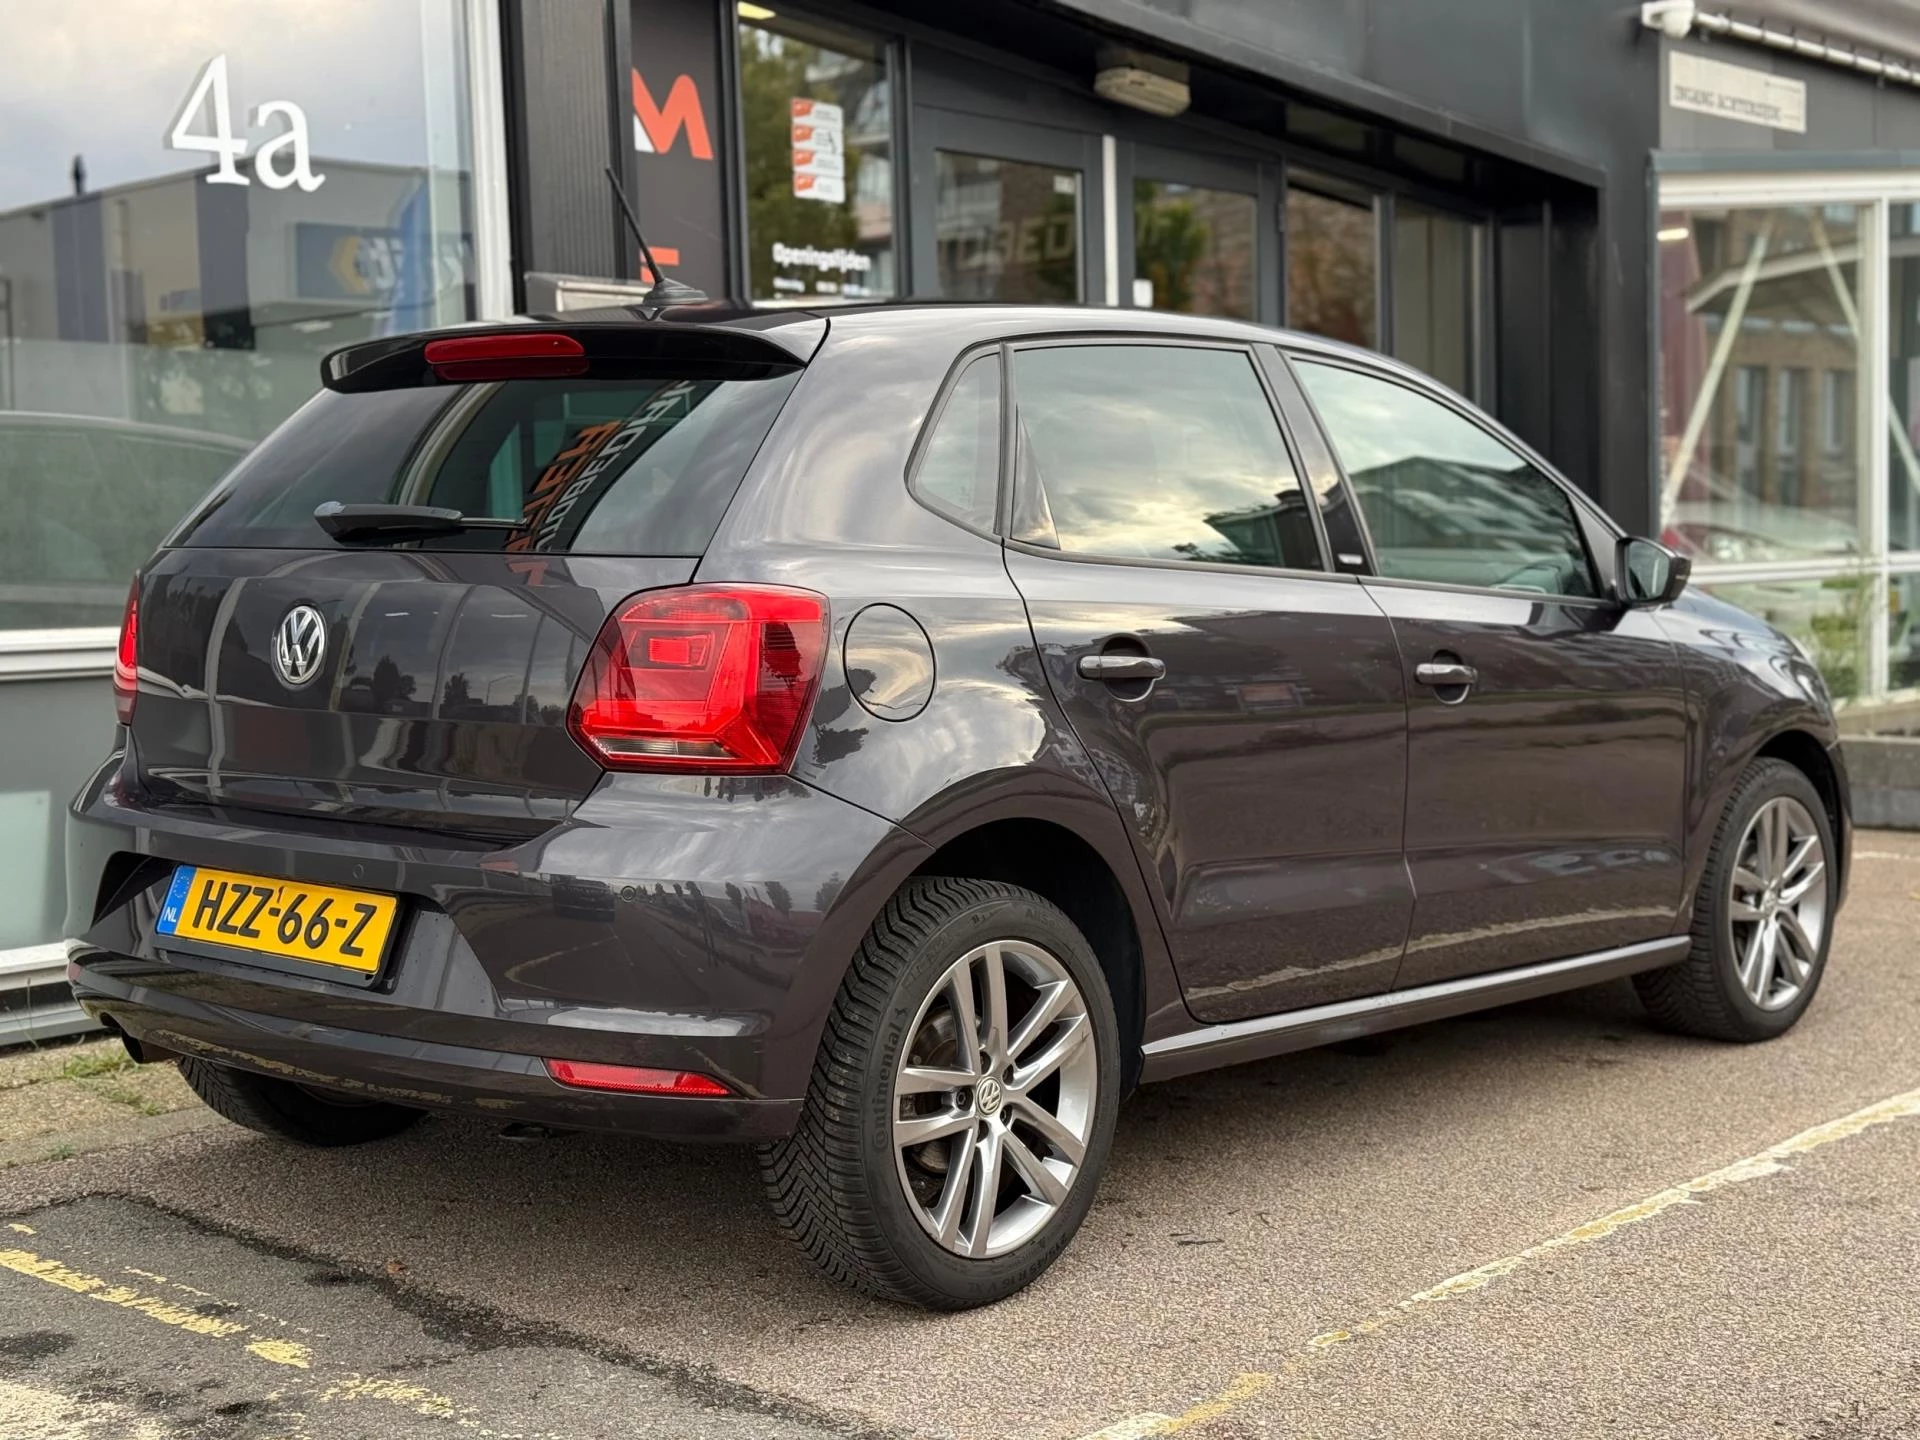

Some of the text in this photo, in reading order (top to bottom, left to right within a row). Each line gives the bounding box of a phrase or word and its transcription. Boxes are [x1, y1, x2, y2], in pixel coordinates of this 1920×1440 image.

[172, 53, 326, 192] 4a
[163, 905, 177, 924] NL
[192, 879, 378, 958] HZZ-66-Z
[871, 1021, 903, 1149] Continental
